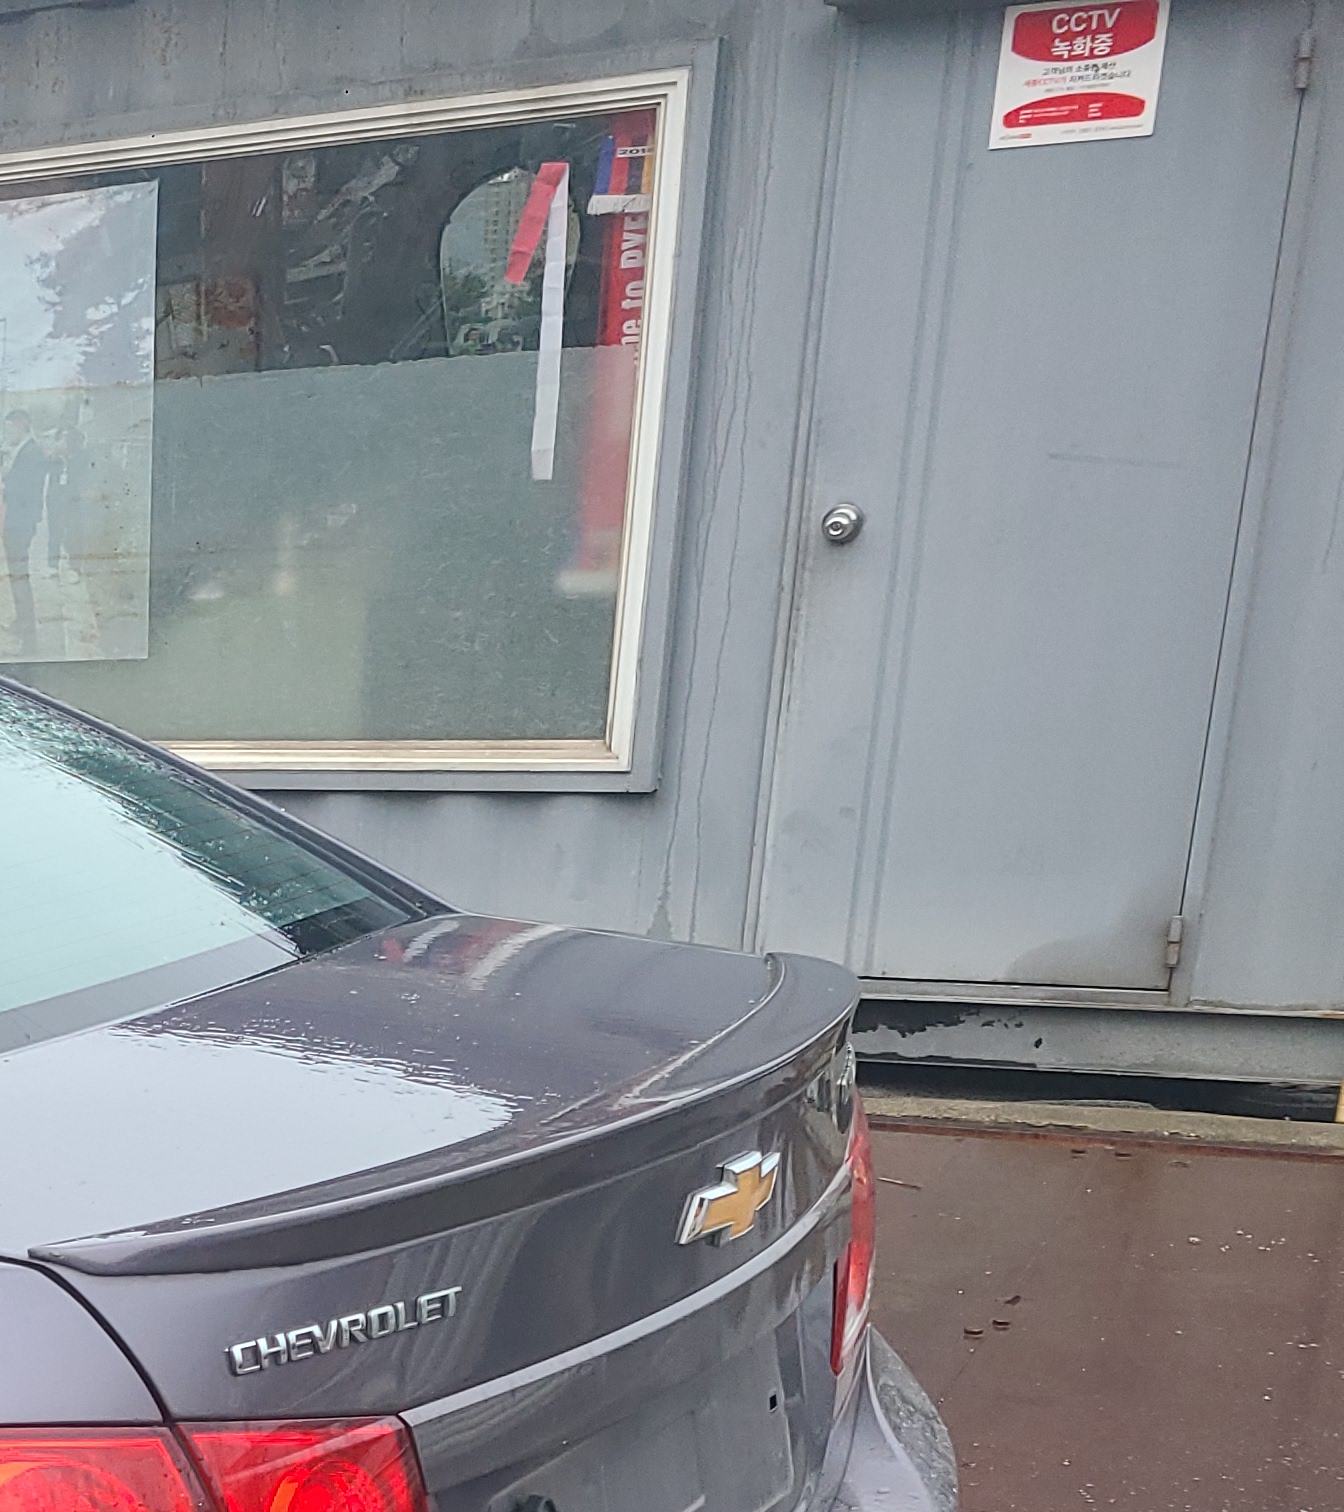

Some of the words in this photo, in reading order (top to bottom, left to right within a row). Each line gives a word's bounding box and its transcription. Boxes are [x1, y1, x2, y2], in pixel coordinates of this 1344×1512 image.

[1052, 8, 1120, 34] CCTV
[1051, 33, 1113, 58] 녹화중
[227, 1286, 462, 1376] CHEVROLET
